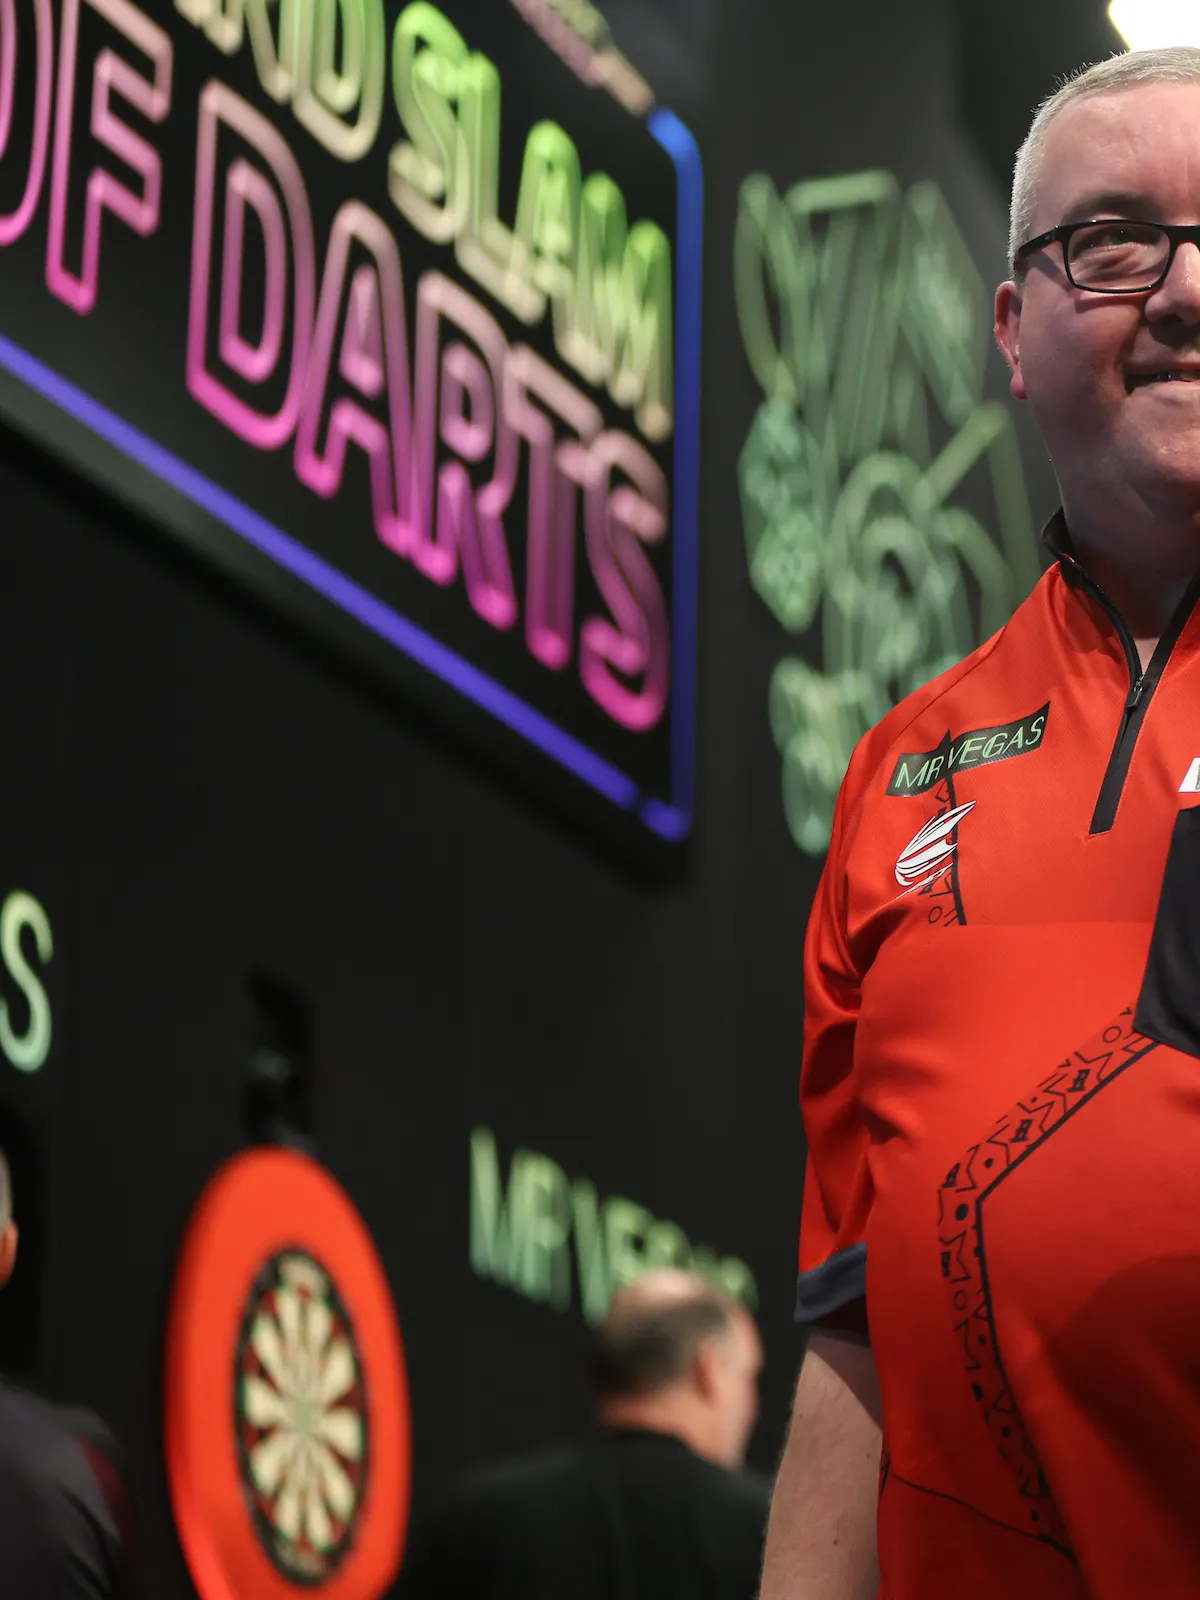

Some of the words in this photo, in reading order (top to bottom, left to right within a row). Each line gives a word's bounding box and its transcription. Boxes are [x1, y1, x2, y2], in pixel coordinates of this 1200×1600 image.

[187, 80, 671, 733] DARTS
[389, 2, 673, 441] SLAM
[894, 755, 945, 789] MR
[947, 715, 1045, 770] VEGAS
